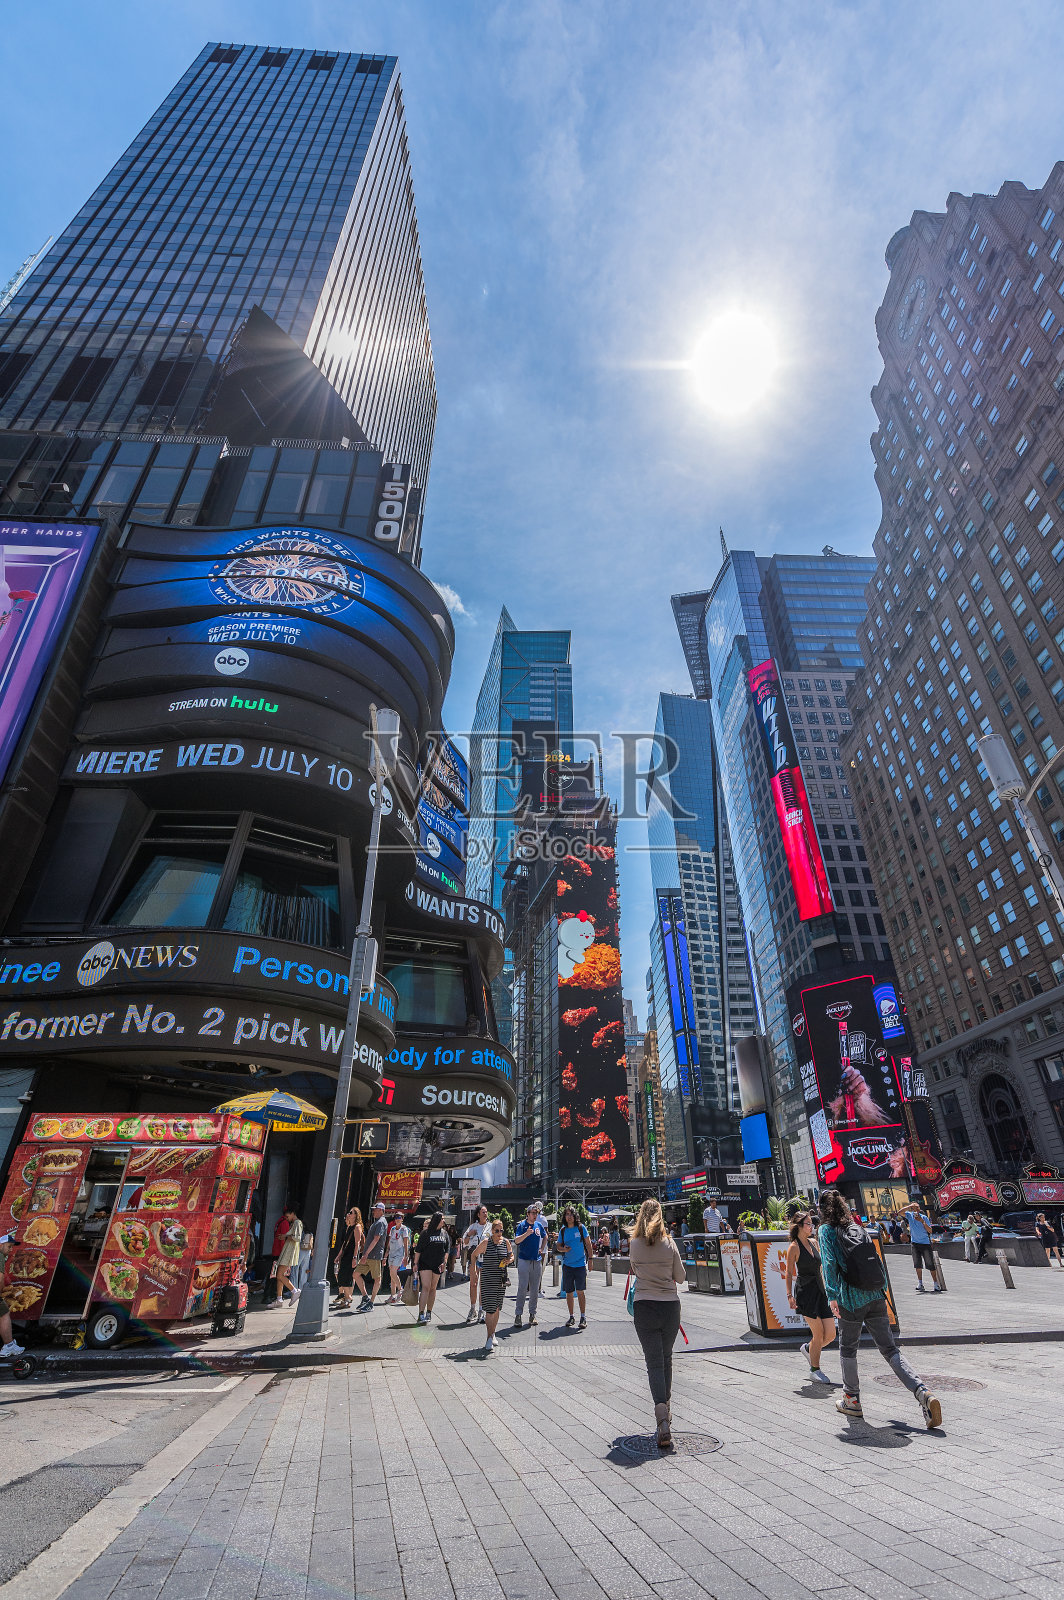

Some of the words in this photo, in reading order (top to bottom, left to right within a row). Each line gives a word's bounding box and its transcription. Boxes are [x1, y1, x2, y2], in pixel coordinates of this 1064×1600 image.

[374, 464, 405, 542] 1500
[36, 529, 83, 537] HANDS
[257, 530, 311, 540] WANTS
[314, 533, 332, 544] TO
[332, 544, 351, 556] BE
[214, 586, 237, 604] WHO
[313, 605, 328, 614] BE
[208, 623, 246, 635] SEASON
[249, 623, 301, 636] PREMIERE
[208, 631, 240, 643] WED
[242, 630, 279, 642] JULY
[283, 634, 297, 644] 10
[217, 655, 247, 667] abc
[169, 699, 209, 712] STREAM
[210, 698, 228, 708] ON
[230, 695, 279, 713] hulu
[763, 696, 787, 770] WILD
[177, 744, 245, 767] WED
[251, 746, 320, 778] JULY
[327, 762, 353, 790] 10
[545, 754, 571, 763] 2024
[441, 871, 459, 894] hulu
[416, 887, 480, 924] WANTS
[483, 909, 498, 934] TO
[80, 954, 112, 972] abc
[112, 945, 200, 970] NEWS
[232, 946, 350, 996] Person
[0, 1011, 115, 1041] former
[121, 1004, 185, 1034] No.
[198, 1007, 226, 1036] 2
[233, 1012, 311, 1048] pick
[882, 1014, 899, 1024] TACO
[884, 1020, 901, 1029] BELL
[433, 1046, 466, 1066] for
[421, 1085, 499, 1113] Sources:
[773, 1144, 783, 1176] SQUARE
[847, 1146, 869, 1157] JACK
[867, 1143, 894, 1154] LINK'S
[381, 1189, 397, 1197] BAKE
[397, 1189, 414, 1197] SHOP
